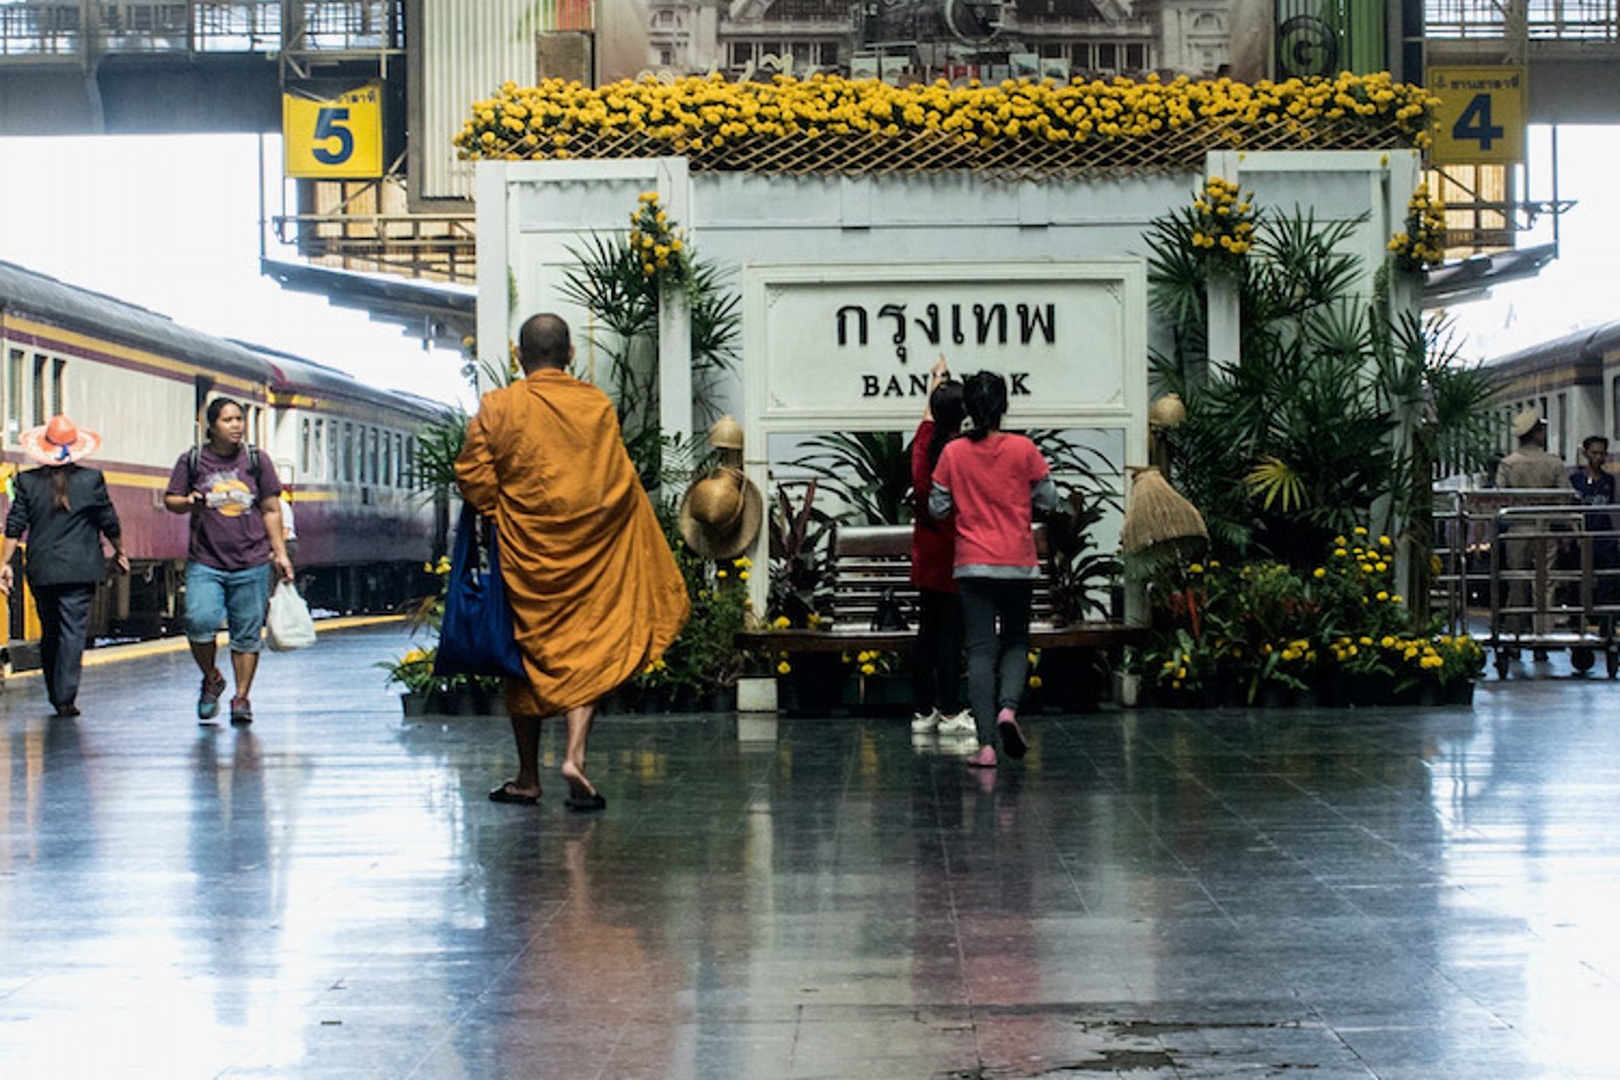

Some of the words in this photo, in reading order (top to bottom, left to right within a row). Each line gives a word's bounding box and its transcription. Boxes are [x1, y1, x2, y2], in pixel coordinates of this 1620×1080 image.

[311, 107, 354, 165] 5
[1452, 93, 1504, 151] 4
[835, 302, 1057, 365] กรุงเทพ
[861, 374, 1032, 398] BANK
